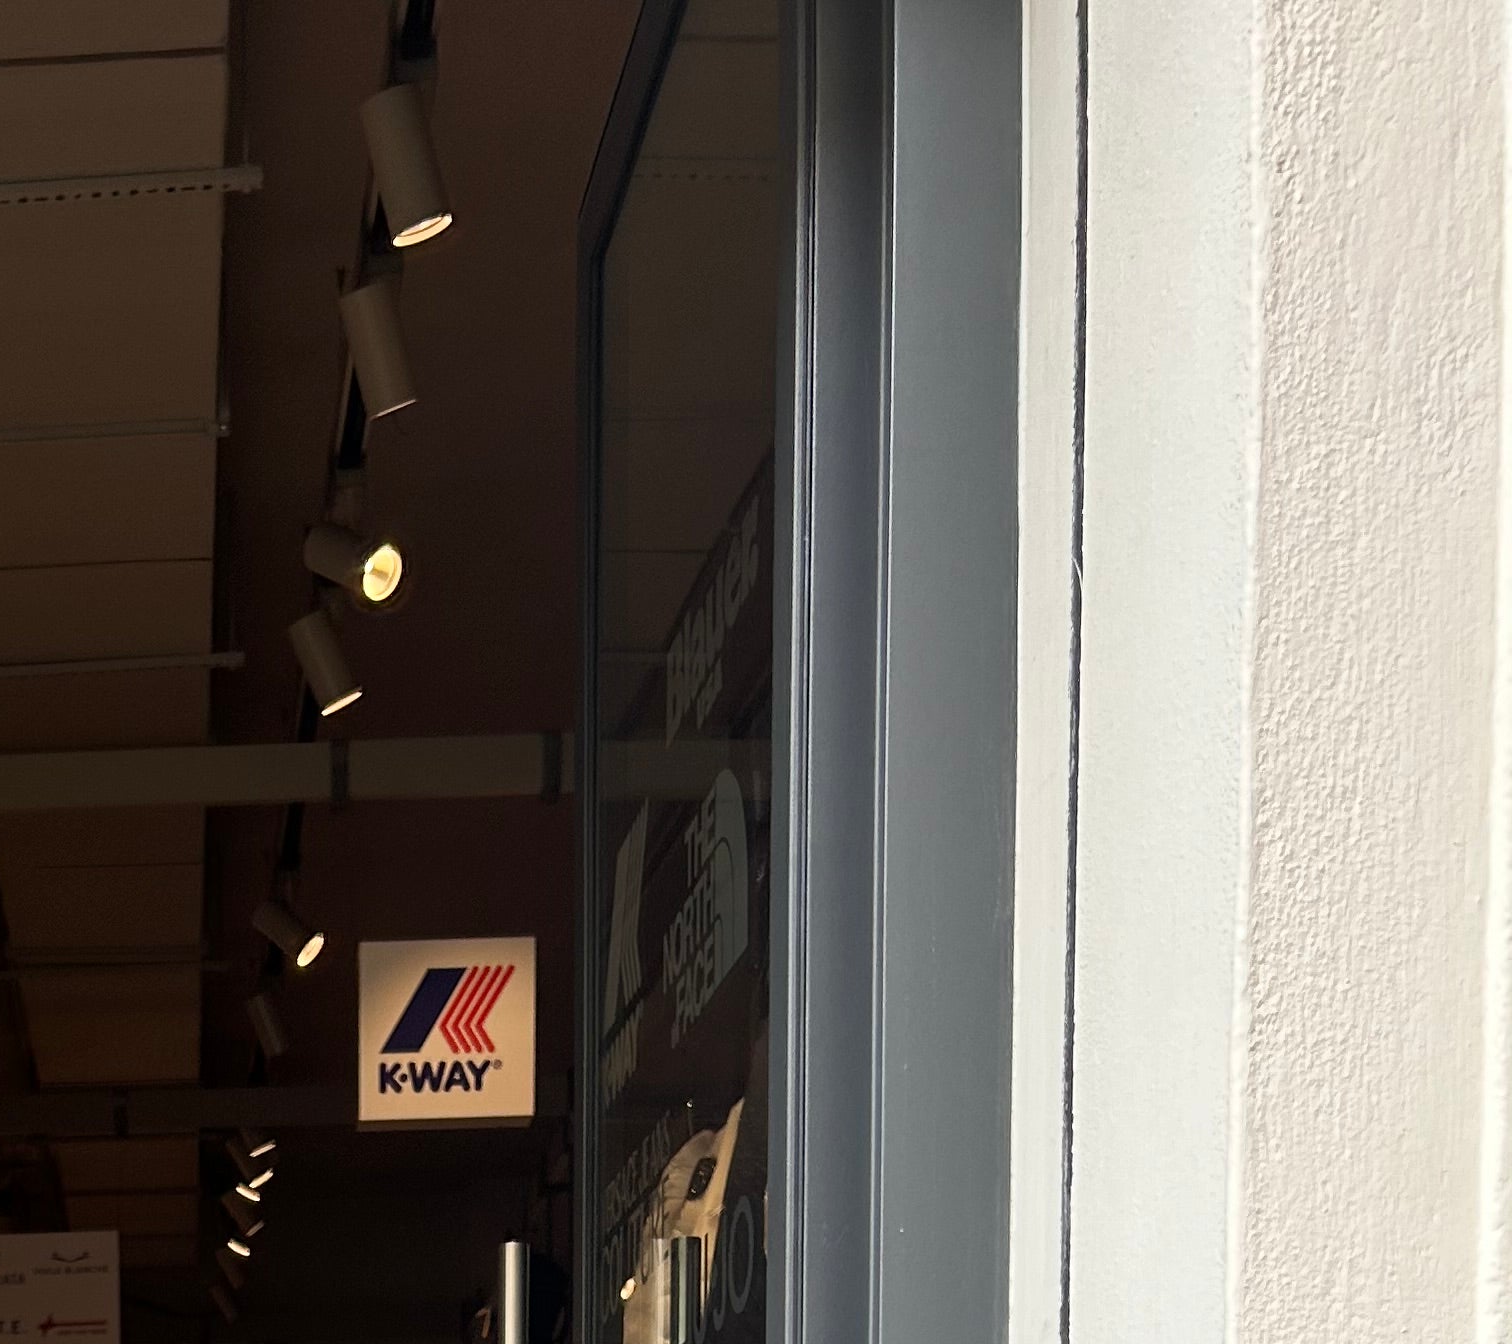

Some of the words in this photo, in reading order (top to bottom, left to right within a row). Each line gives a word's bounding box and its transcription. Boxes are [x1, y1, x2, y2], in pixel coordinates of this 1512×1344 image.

[684, 786, 716, 884] THE
[663, 861, 716, 996] NORTH
[675, 932, 716, 1036] FACE
